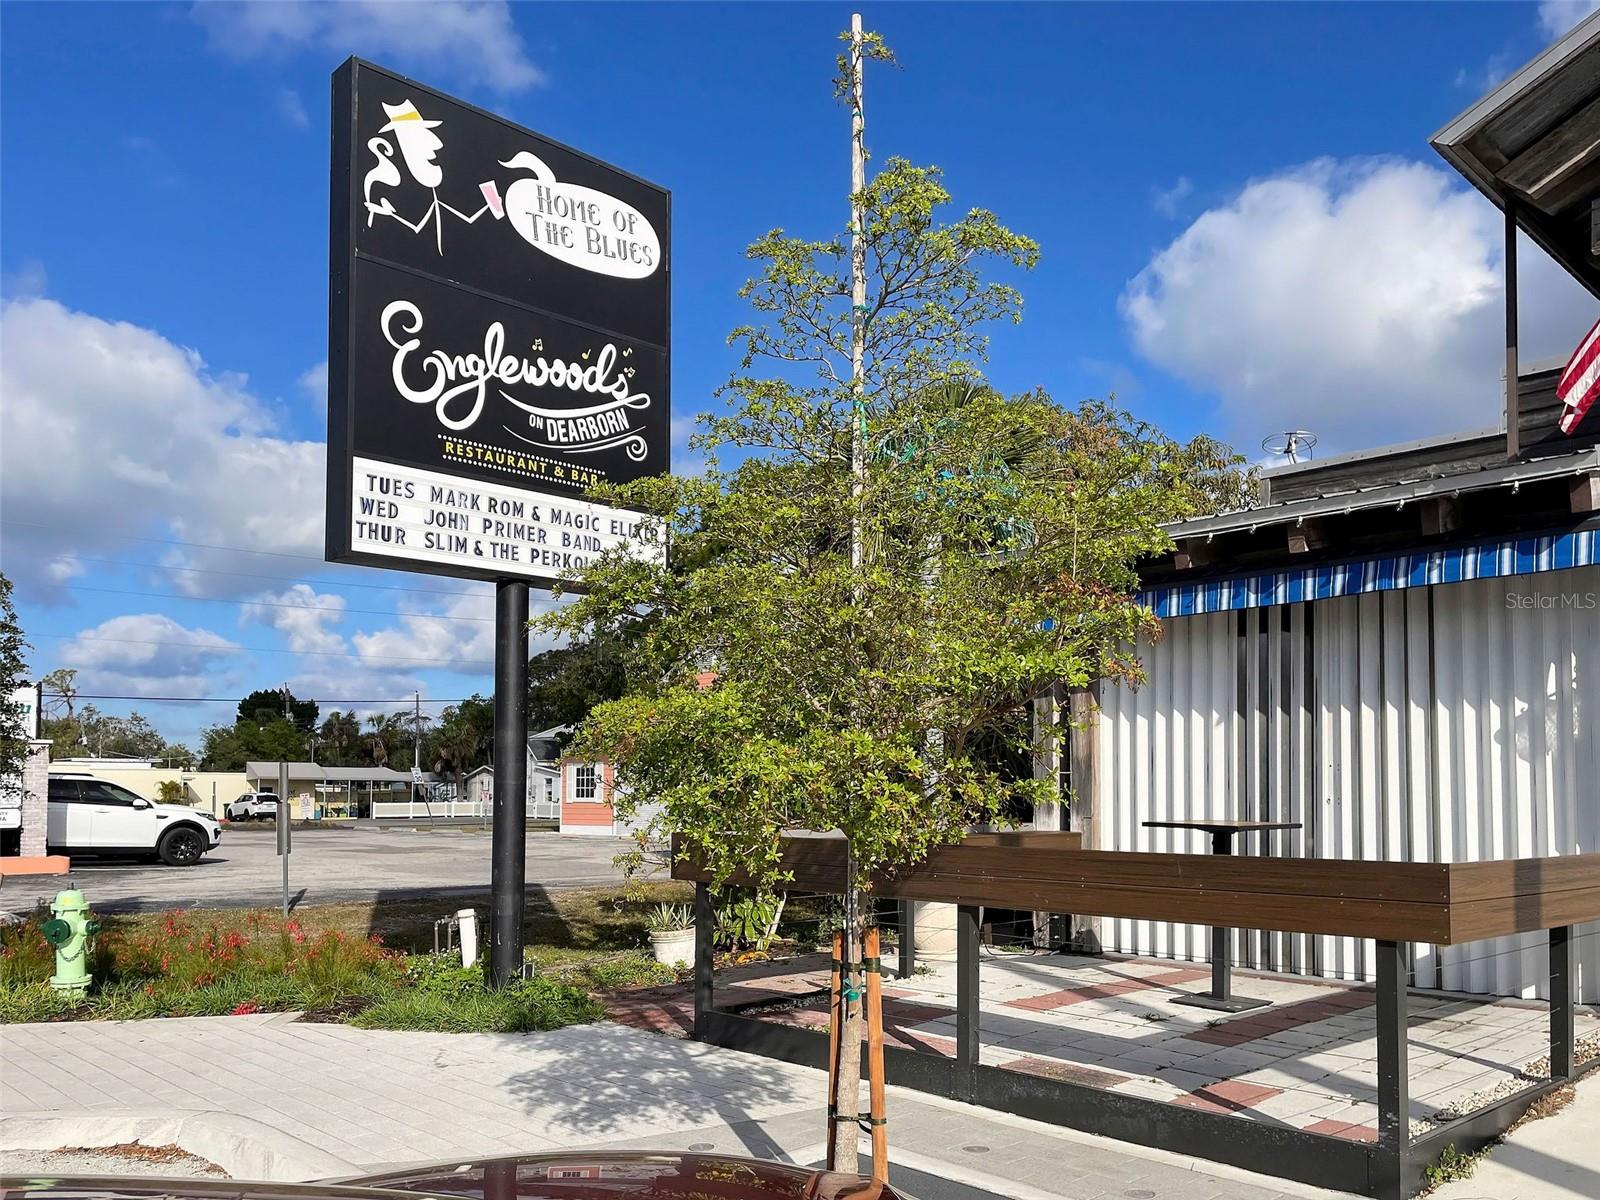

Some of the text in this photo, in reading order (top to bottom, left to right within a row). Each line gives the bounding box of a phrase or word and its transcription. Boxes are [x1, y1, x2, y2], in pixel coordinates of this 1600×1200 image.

[529, 408, 630, 442] ON DEARBORN
[445, 442, 599, 488] RESTAURANT & BAR
[359, 496, 601, 553] WED JOHN PRIMER BAND
[366, 474, 415, 499] TUES
[430, 485, 480, 511] MARK
[487, 496, 524, 518] ROM
[531, 506, 541, 522] &
[550, 508, 600, 532] MAGIC
[356, 520, 406, 545] THUR
[424, 531, 467, 554] SLIM
[473, 541, 483, 556] &
[490, 541, 519, 561] THE
